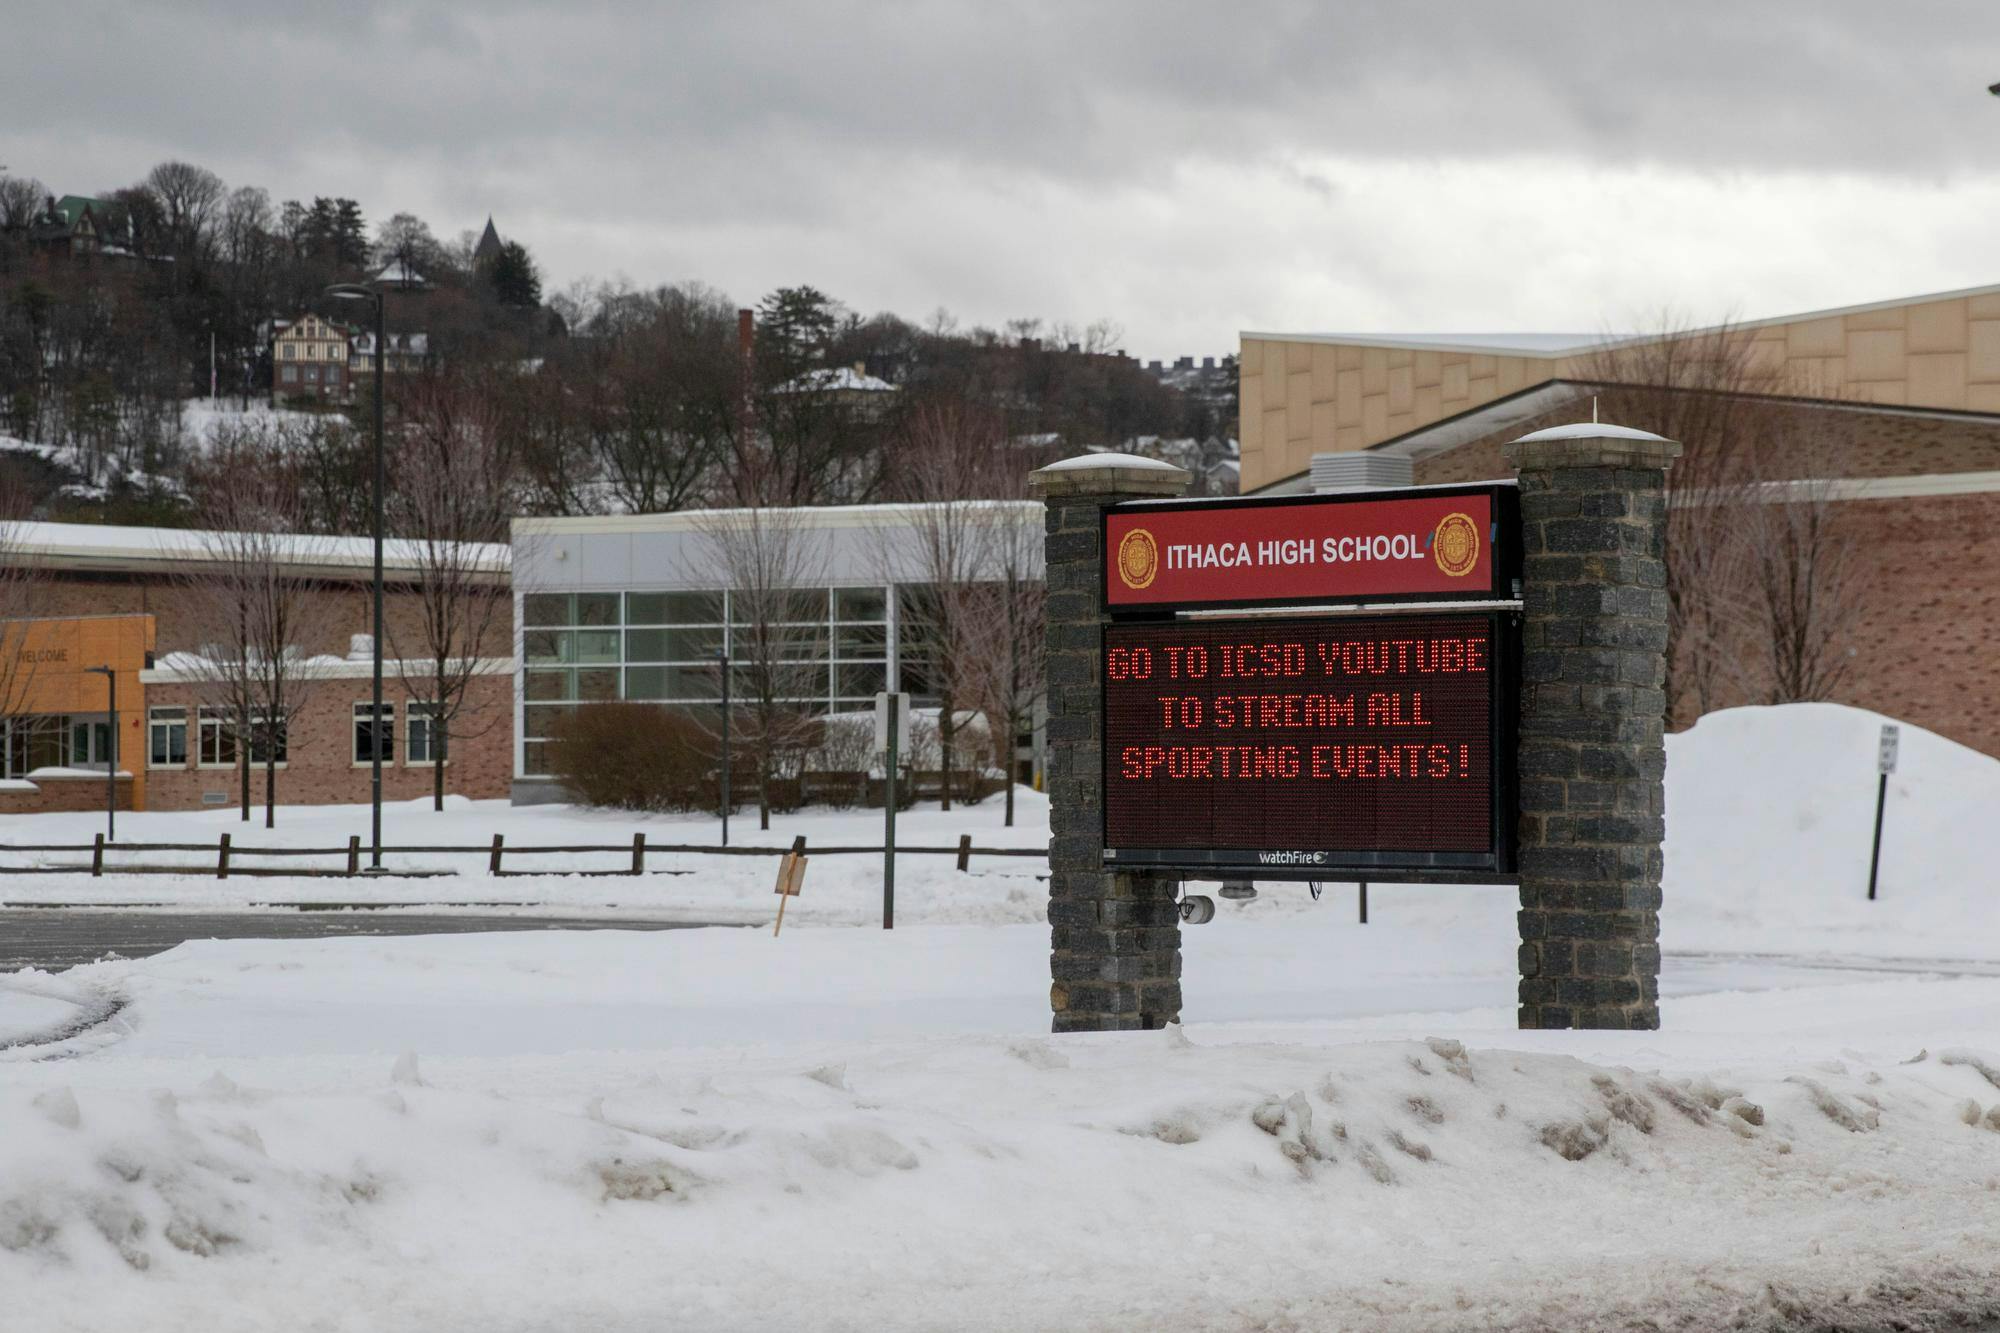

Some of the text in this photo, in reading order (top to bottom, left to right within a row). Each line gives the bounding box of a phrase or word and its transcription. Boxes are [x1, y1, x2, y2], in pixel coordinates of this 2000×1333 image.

[1167, 542, 1252, 569] ITHACA
[1258, 539, 1315, 566] HIGH
[1322, 534, 1425, 563] SCHOOL
[18, 648, 68, 664] WELCOME
[1108, 638, 1486, 680] GO TO ICSD YOUTUBE
[1158, 691, 1432, 729] TO STREAM ALL
[1122, 744, 1469, 779] SPORTING EVENTS!
